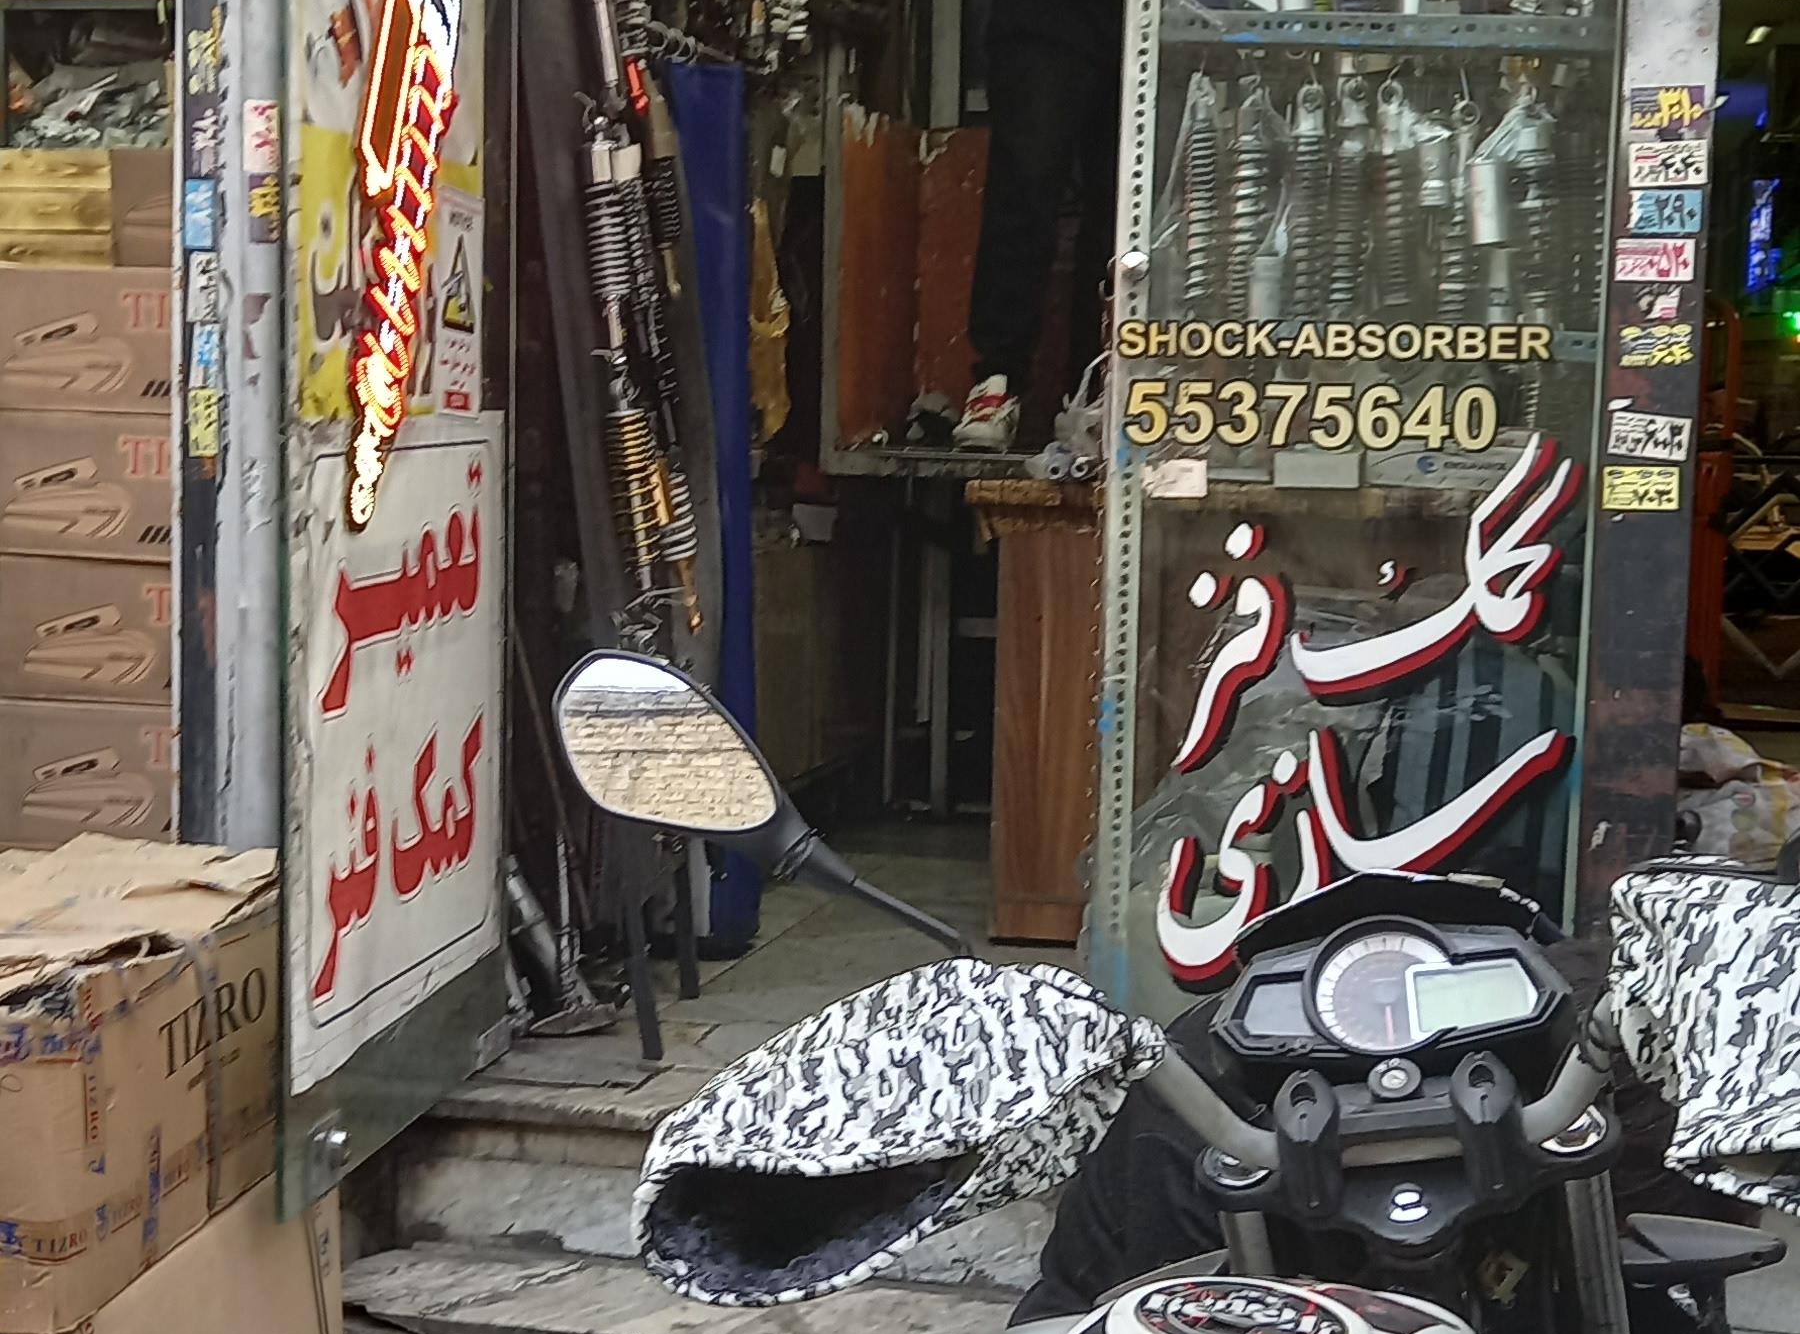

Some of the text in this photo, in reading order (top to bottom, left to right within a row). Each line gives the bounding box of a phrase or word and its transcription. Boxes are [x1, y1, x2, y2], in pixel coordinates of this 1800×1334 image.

[1117, 319, 1553, 361] SHOCK-ABSORBER
[1123, 379, 1498, 452] 55375640
[319, 465, 481, 717] تعمیر
[313, 707, 482, 1004] کمک فنر
[159, 967, 266, 1080] TIZRO
